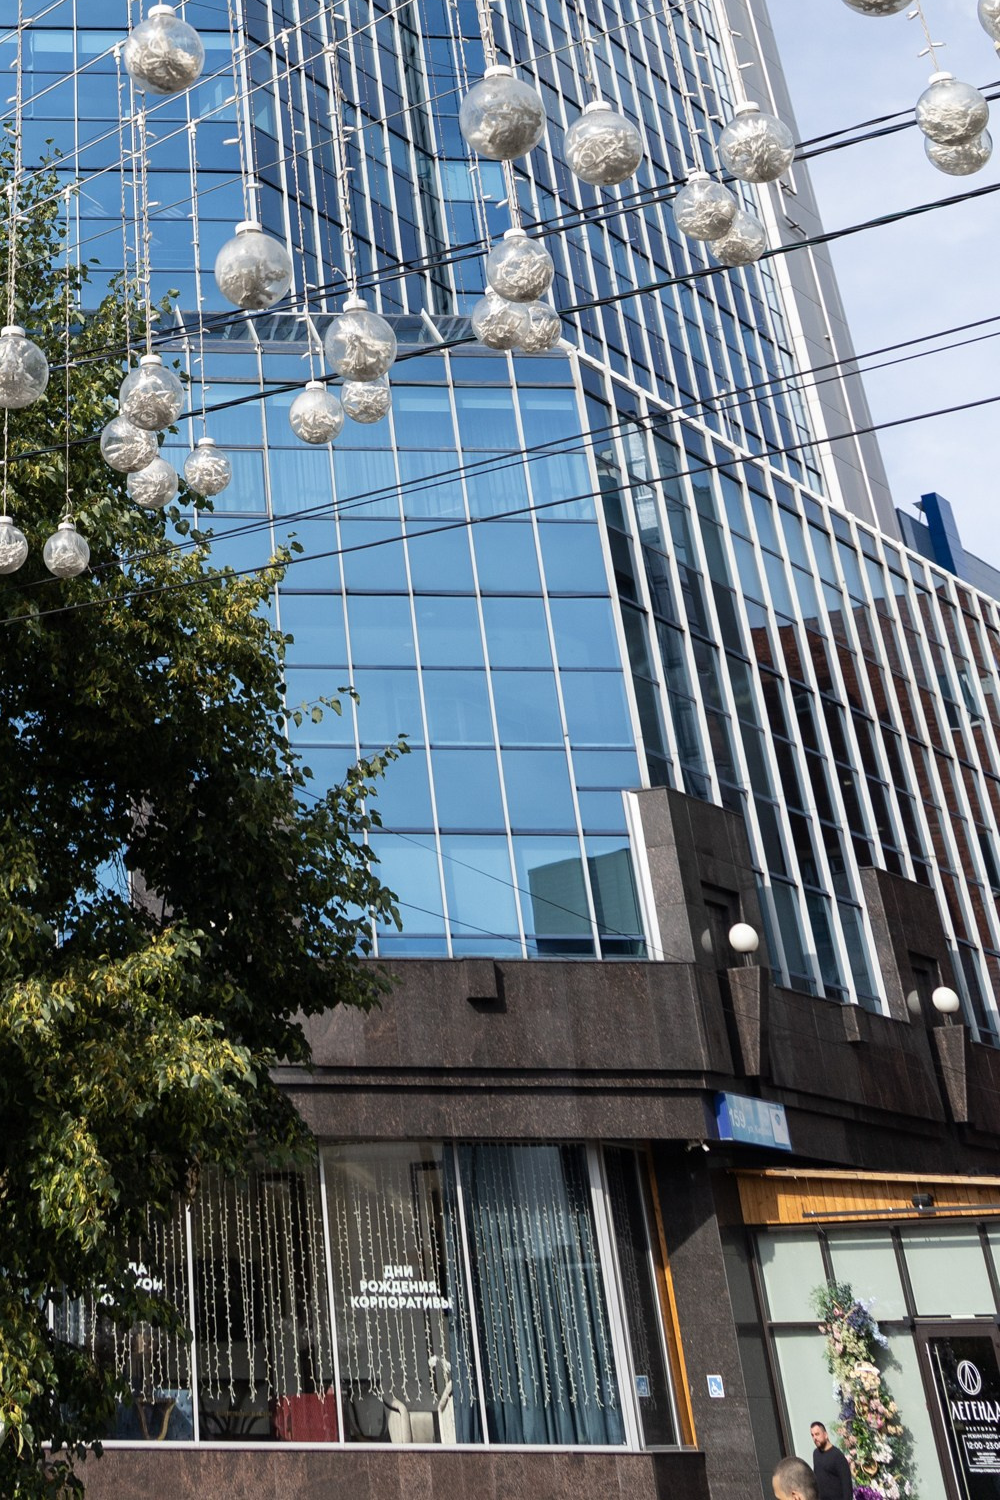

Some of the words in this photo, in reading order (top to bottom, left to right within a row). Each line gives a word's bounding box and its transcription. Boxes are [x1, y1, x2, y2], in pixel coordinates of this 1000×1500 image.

[728, 1108, 746, 1128] 159
[383, 1265, 413, 1279] ДНИ
[360, 1280, 441, 1295] РОЖДЕНИЯ,
[350, 1296, 453, 1308] КОРПОРАТИВЫ
